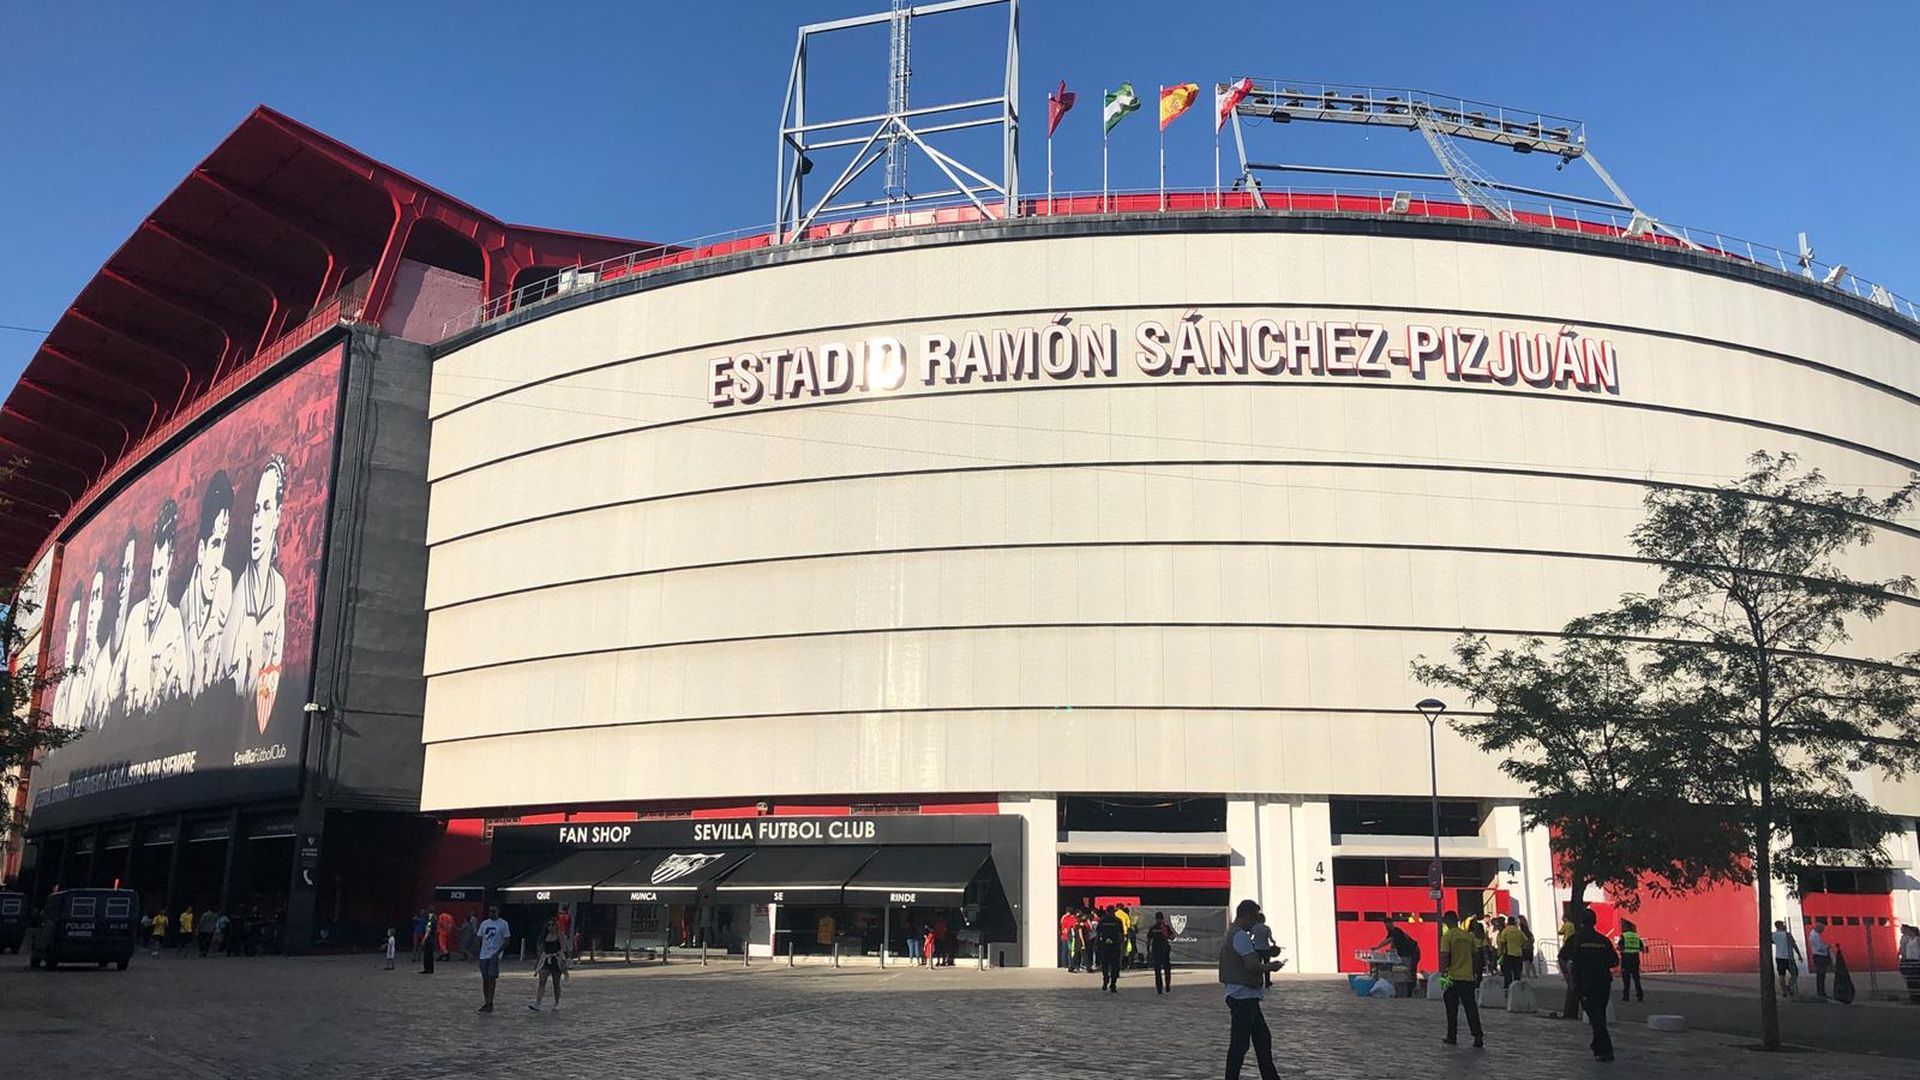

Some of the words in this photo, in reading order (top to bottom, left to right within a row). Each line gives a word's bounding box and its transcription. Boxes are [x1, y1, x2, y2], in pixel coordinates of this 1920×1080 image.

[708, 335, 907, 408] ESTADIO
[920, 312, 1118, 387] RAMÓN
[1135, 307, 1620, 396] SÁNCHEZ-PIZJUÁN
[161, 750, 197, 780] SIEMPRE
[559, 827, 588, 843] FAN
[591, 826, 632, 843] SHOP
[694, 823, 754, 841] SEVILLA
[759, 821, 823, 840] FUTBOL
[828, 820, 876, 839] CLUB
[1315, 861, 1324, 875] 4
[536, 891, 551, 901] QUE
[630, 891, 657, 902] NUNCA
[773, 891, 784, 902] SE
[890, 893, 916, 904] RINDE
